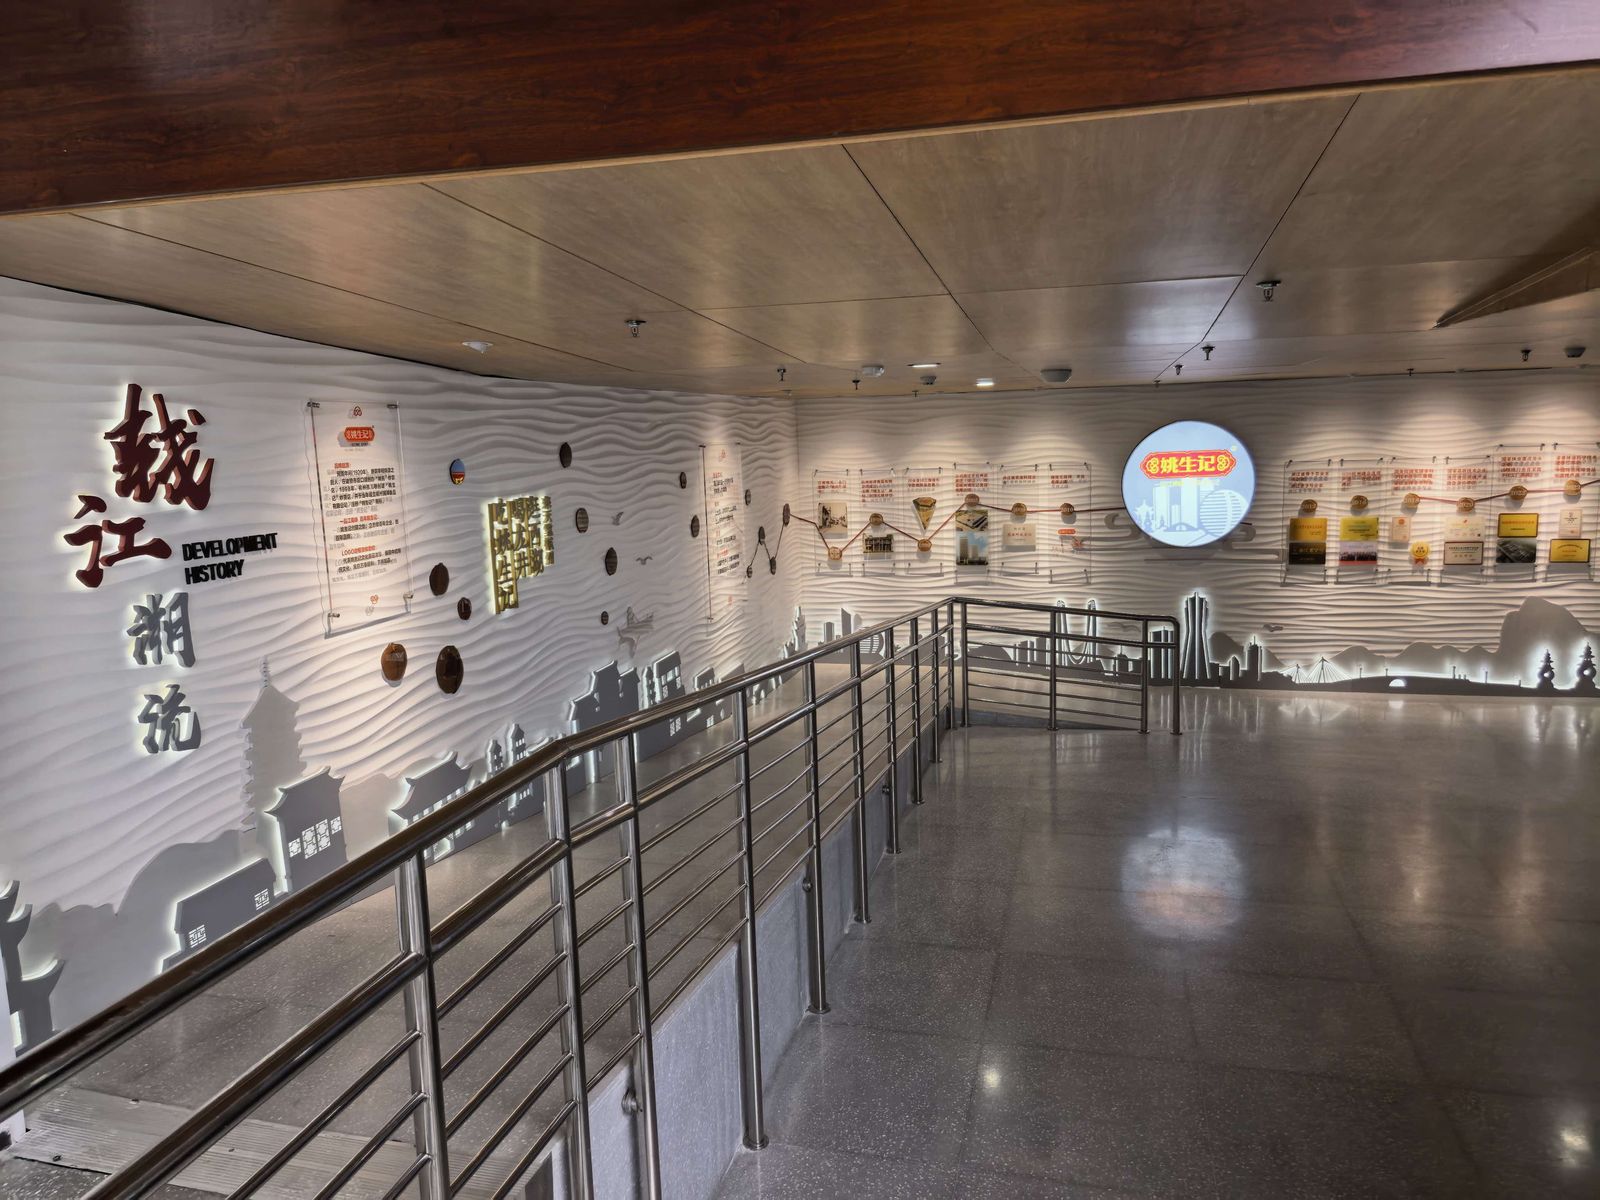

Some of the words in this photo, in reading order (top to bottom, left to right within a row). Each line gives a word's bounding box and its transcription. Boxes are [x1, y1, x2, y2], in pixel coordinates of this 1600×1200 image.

[1161, 455, 1216, 473] 姚生记
[182, 532, 278, 561] DEVELOPMENT
[492, 498, 519, 613] 吃姚生记
[184, 559, 245, 585] HISTORY
